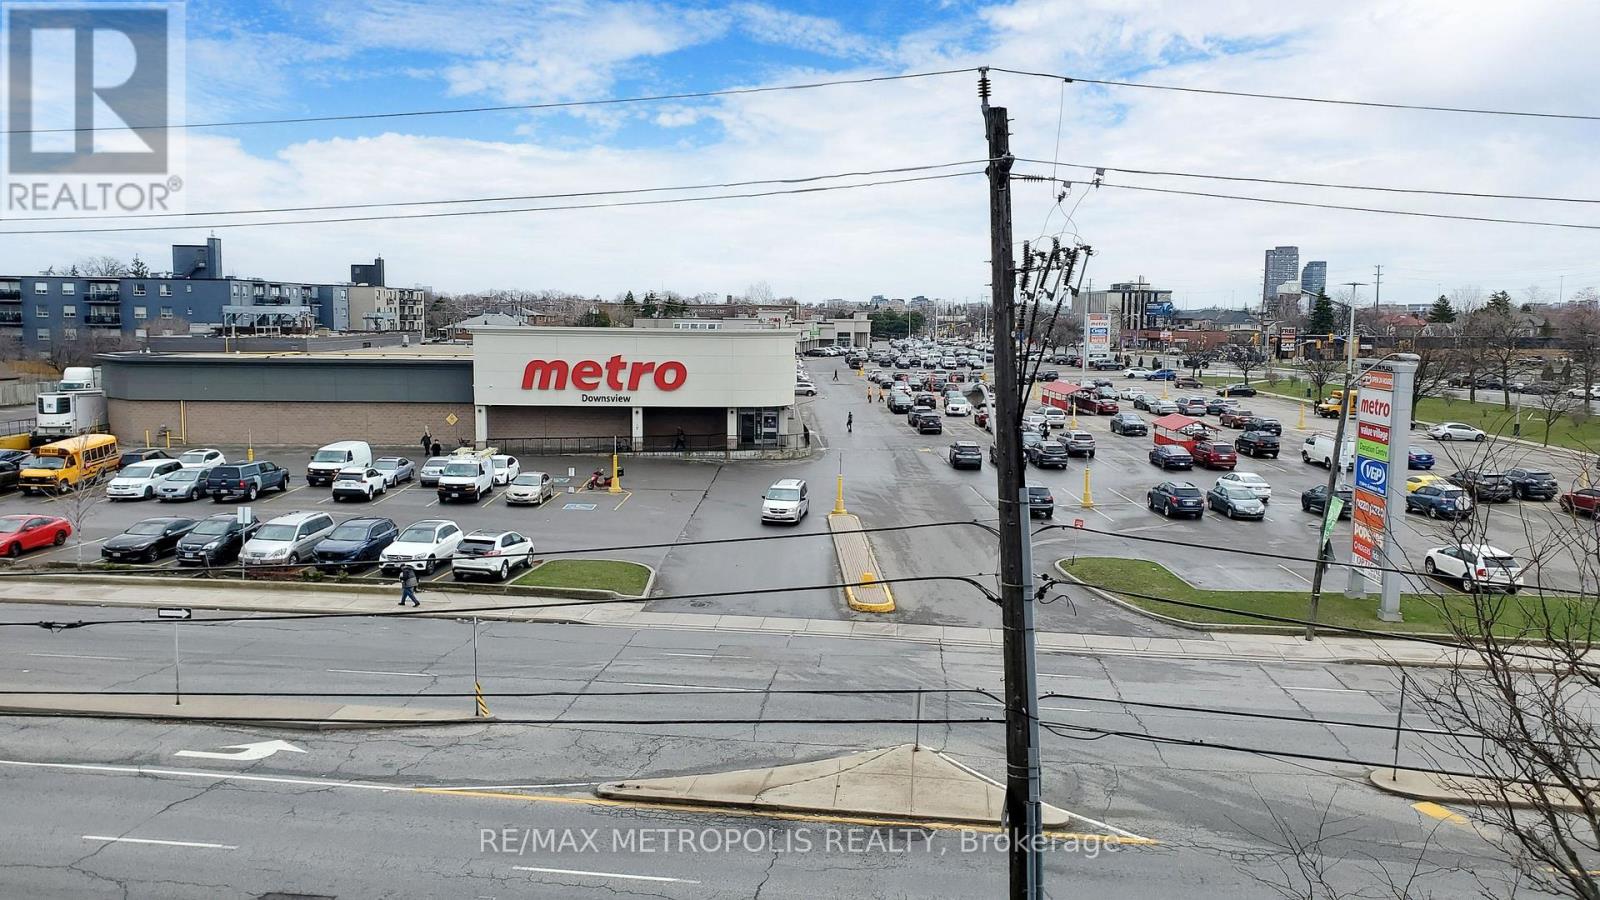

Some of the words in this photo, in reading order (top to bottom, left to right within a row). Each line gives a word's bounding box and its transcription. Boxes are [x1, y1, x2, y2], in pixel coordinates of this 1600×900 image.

[521, 354, 688, 392] metro
[581, 393, 631, 403] Downsview
[1360, 398, 1390, 417] metro
